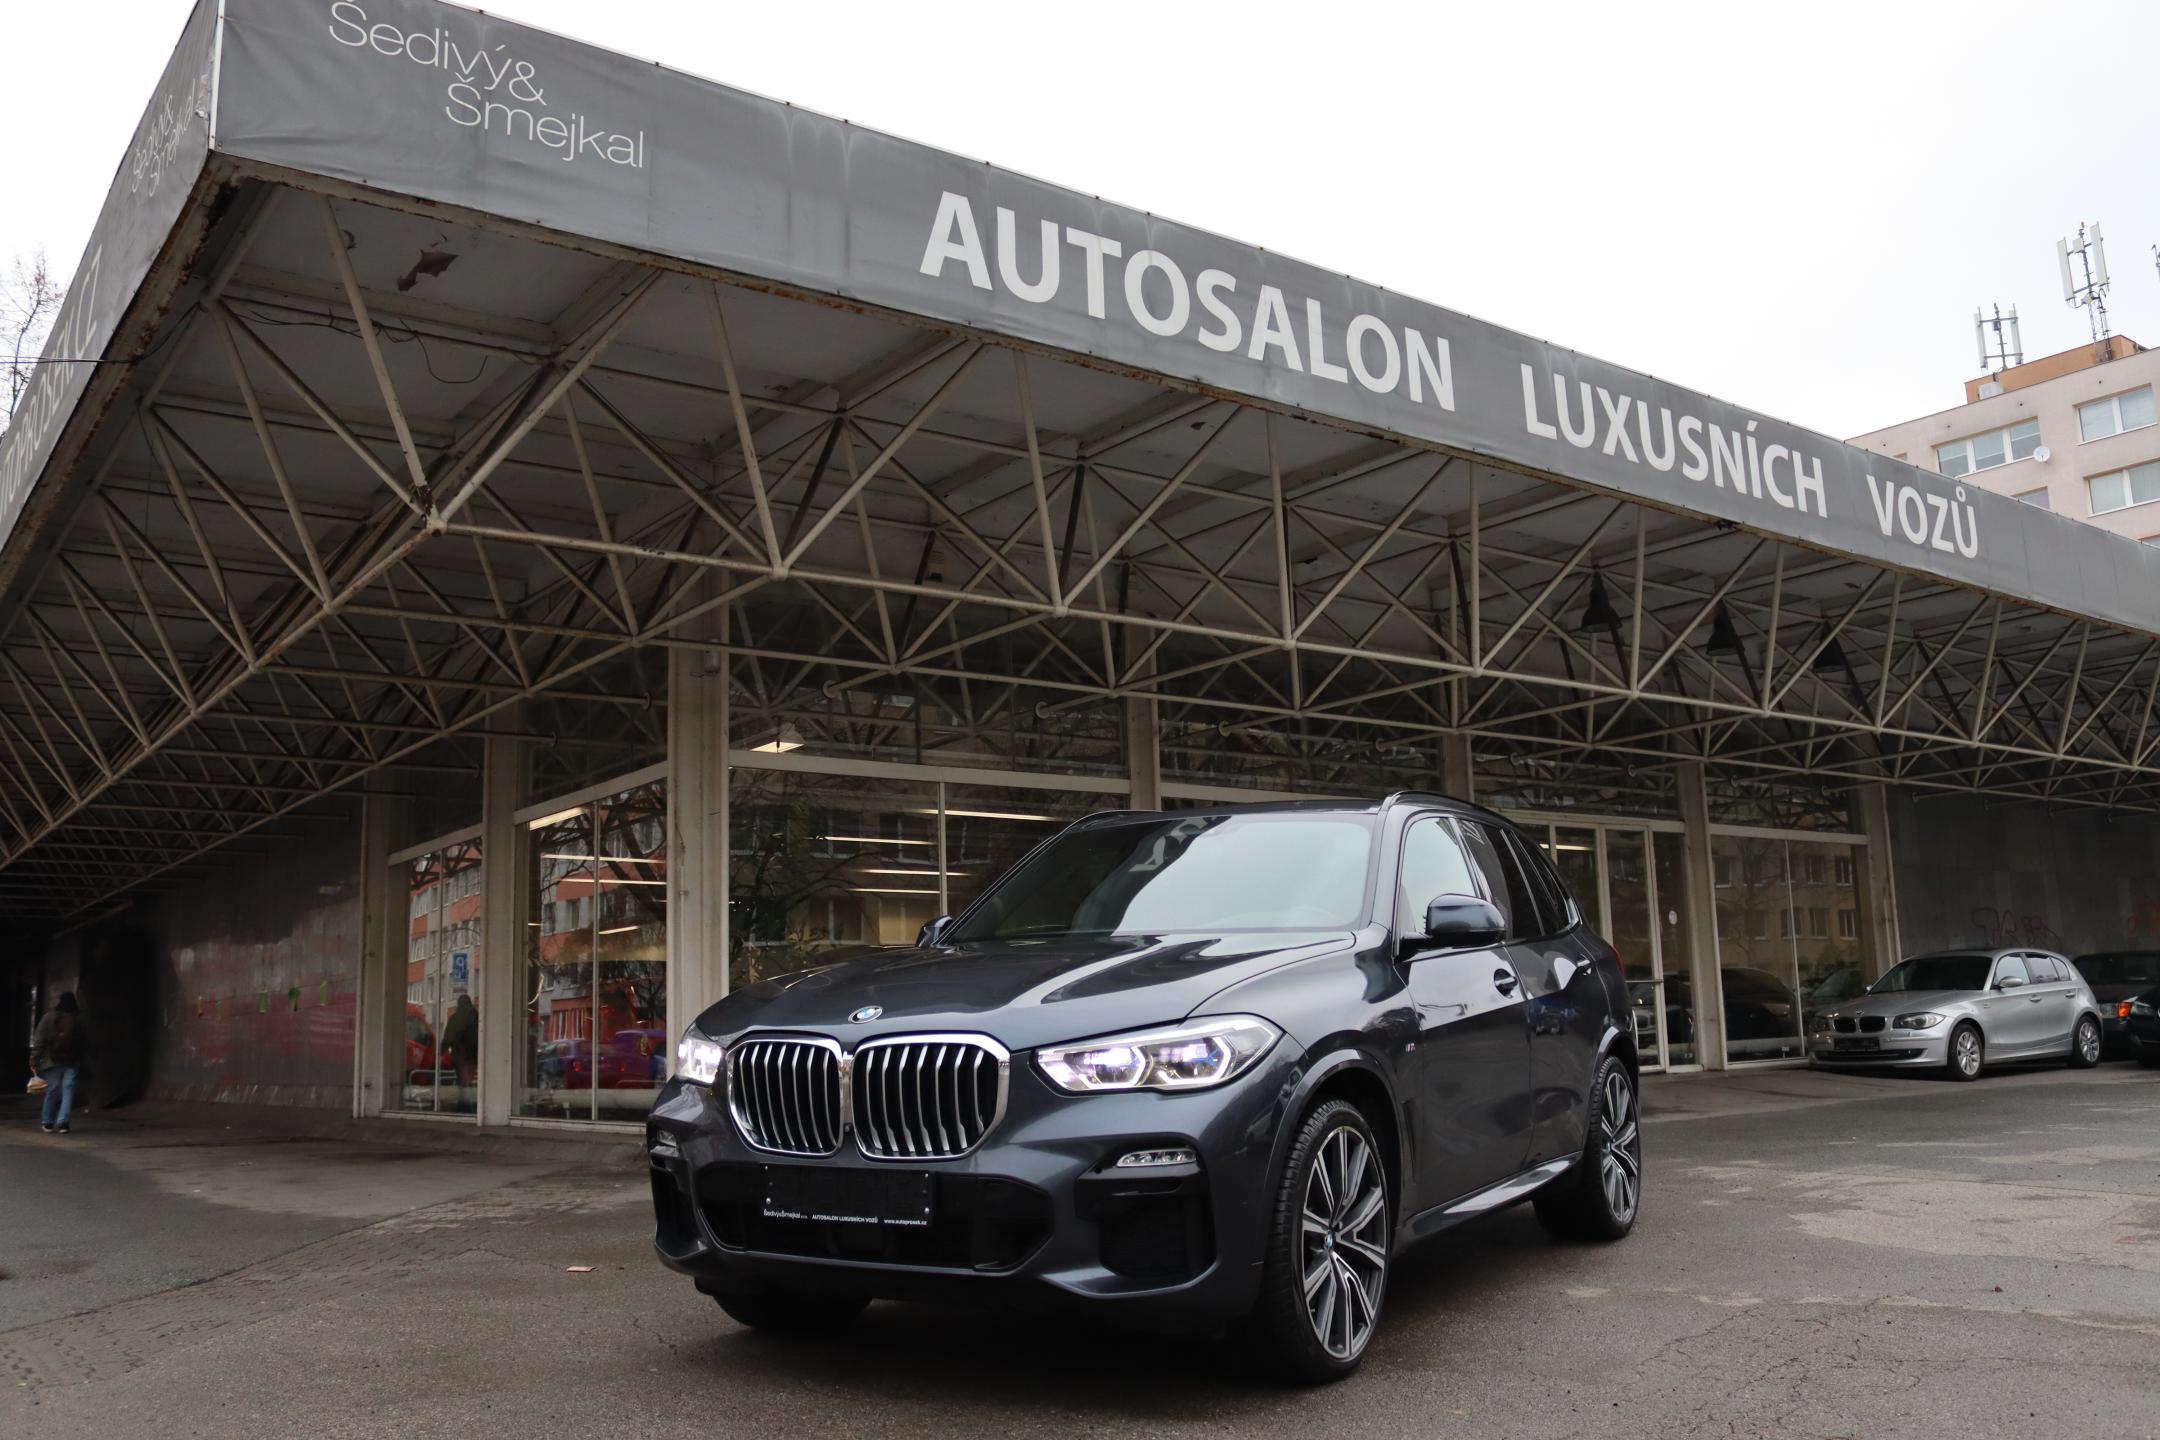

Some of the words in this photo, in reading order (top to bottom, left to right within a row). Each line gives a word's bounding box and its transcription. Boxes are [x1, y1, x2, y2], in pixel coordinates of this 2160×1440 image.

[446, 72, 644, 168] Šmejkal
[919, 190, 1456, 412] AUTOSALON
[1520, 363, 1829, 518] LUXUSNÍCH
[1866, 474, 1979, 559] VOZŮ
